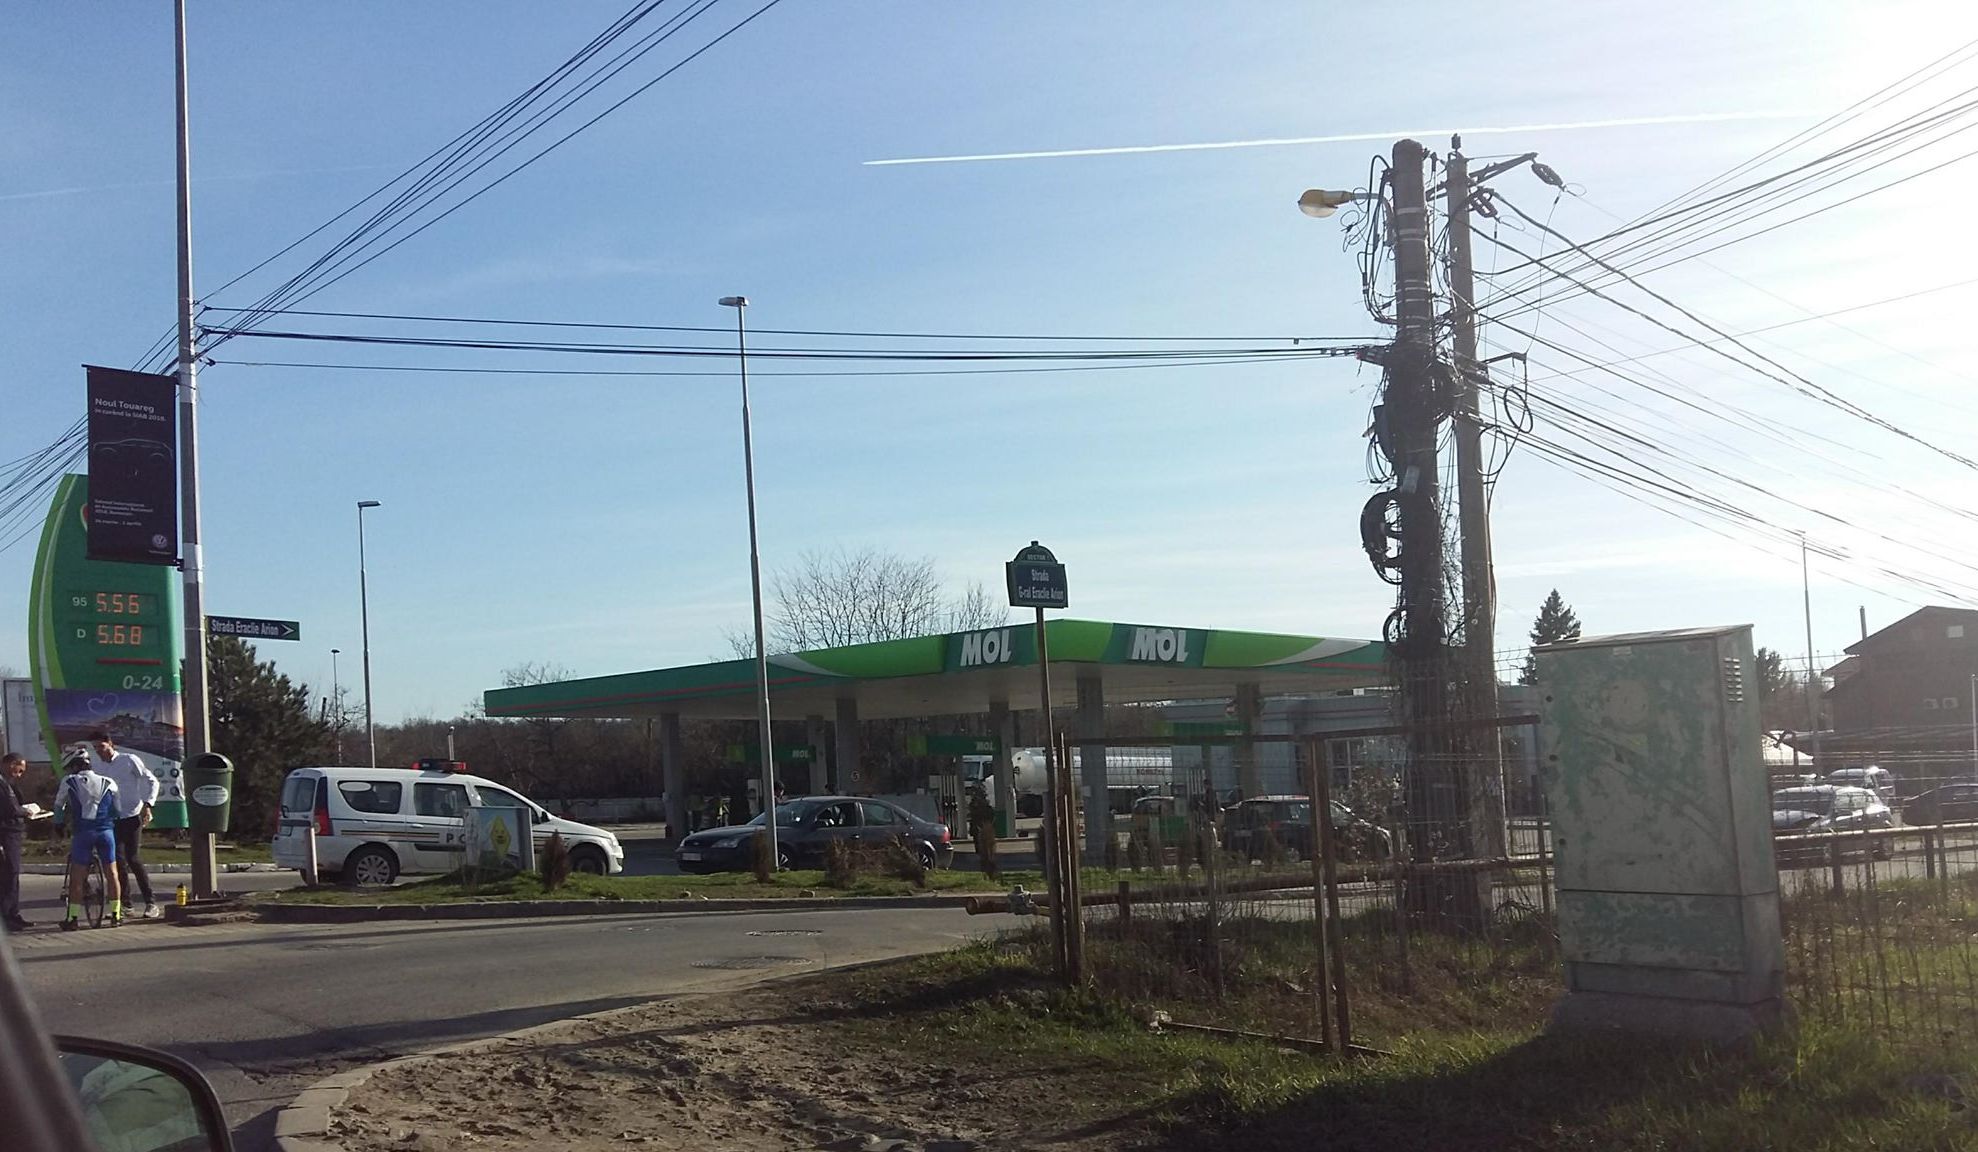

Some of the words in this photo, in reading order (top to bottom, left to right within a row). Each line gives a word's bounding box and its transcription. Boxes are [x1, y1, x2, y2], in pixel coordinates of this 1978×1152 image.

[95, 398, 117, 408] Noul
[118, 400, 155, 414] Touareg
[72, 597, 88, 607] 95
[96, 592, 140, 614] 5.56
[77, 628, 86, 638] D
[97, 624, 142, 645] 5.68
[211, 618, 235, 633] Strada
[261, 622, 279, 636] Arion
[960, 629, 1012, 667] MOL
[1130, 627, 1189, 662] MOL
[122, 675, 162, 690] 0-24
[792, 749, 809, 759] MOL
